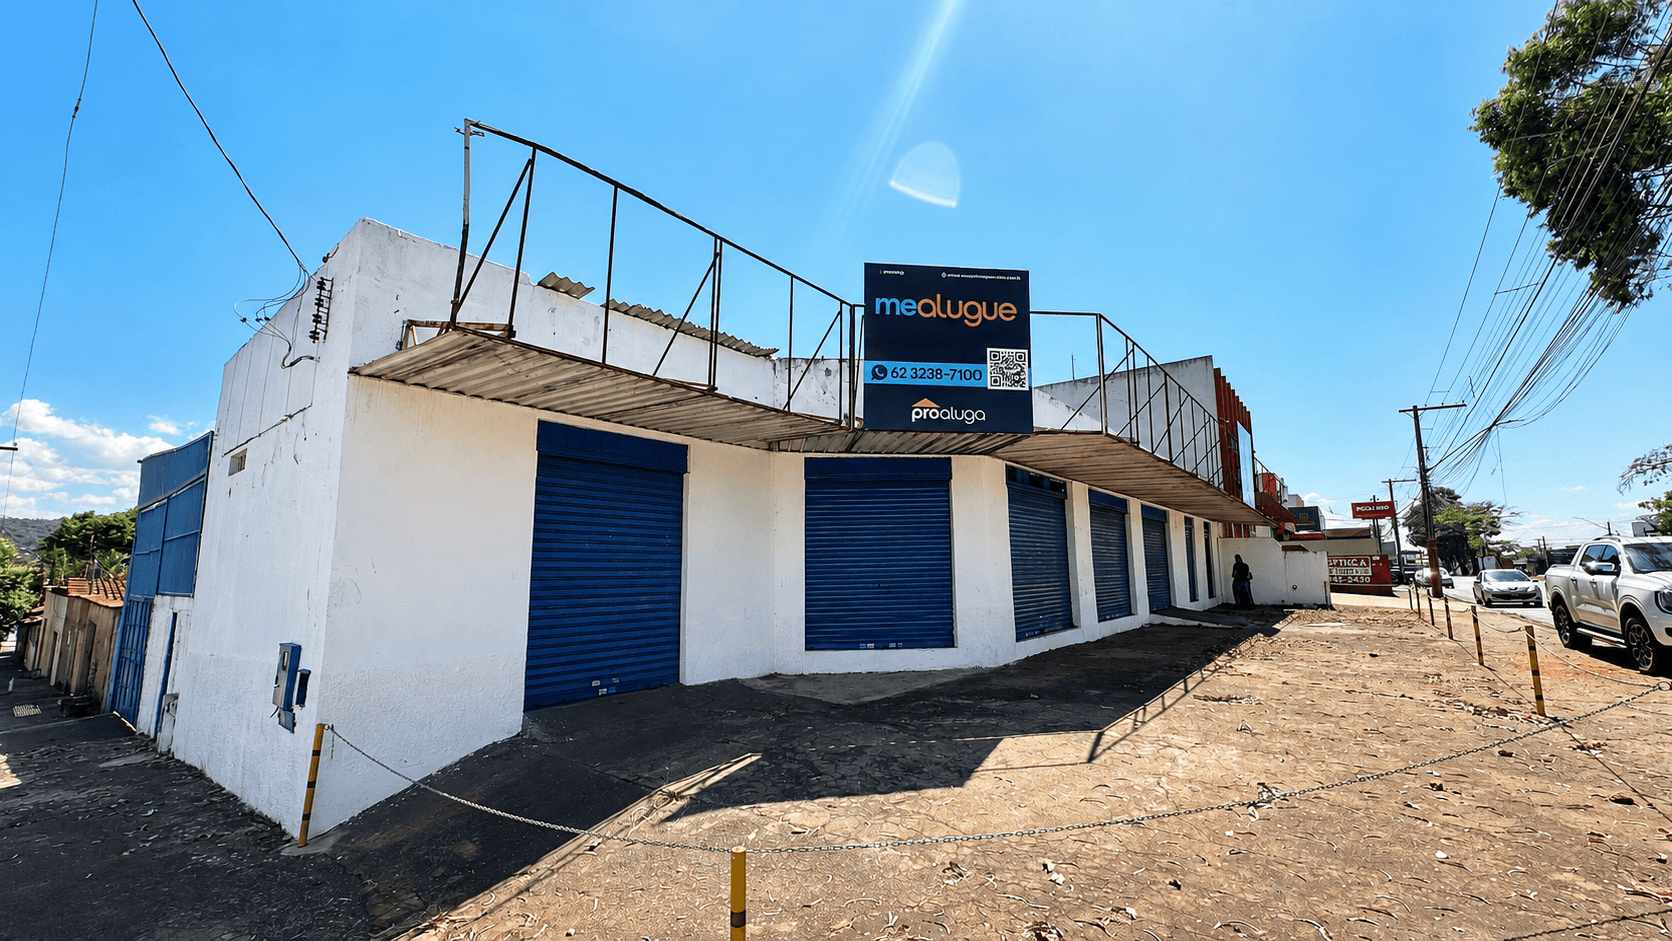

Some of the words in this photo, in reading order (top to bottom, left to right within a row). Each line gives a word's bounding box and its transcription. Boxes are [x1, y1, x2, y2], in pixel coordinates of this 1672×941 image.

[875, 293, 1017, 327] mealugue
[890, 366, 907, 379] 62
[910, 367, 982, 380] 3238-7100
[911, 406, 985, 424] proaluga
